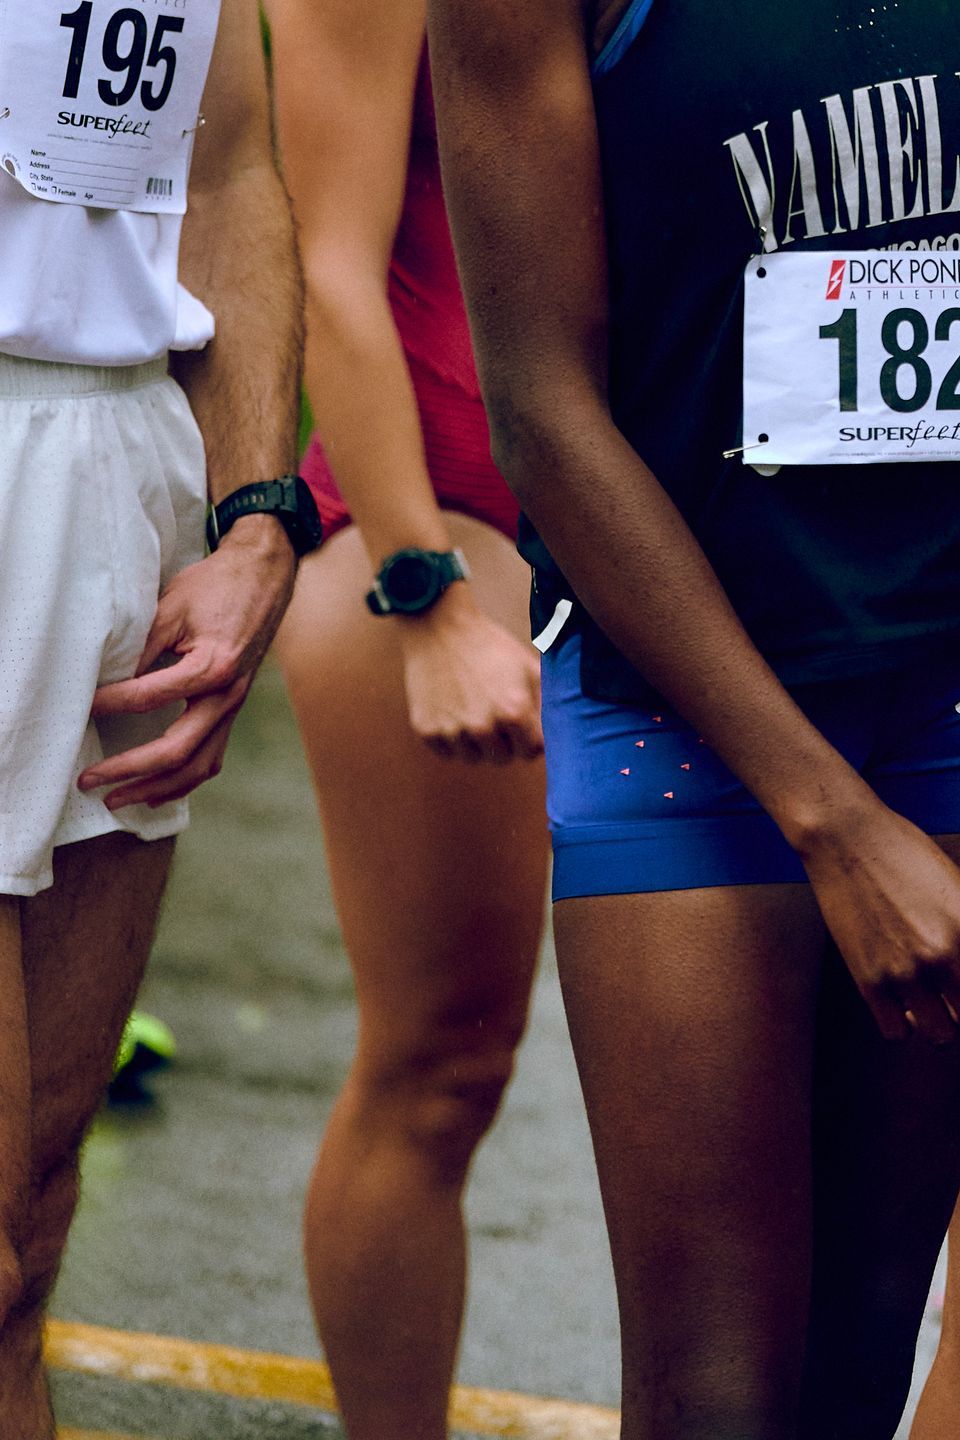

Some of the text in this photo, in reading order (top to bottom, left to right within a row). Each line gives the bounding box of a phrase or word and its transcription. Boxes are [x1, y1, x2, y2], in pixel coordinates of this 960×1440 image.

[59, 0, 185, 111] 195
[57, 111, 151, 139] SUPERfeet
[31, 149, 46, 157] Name
[30, 161, 50, 169] Address
[41, 174, 53, 182] State
[850, 259, 904, 283] DICK
